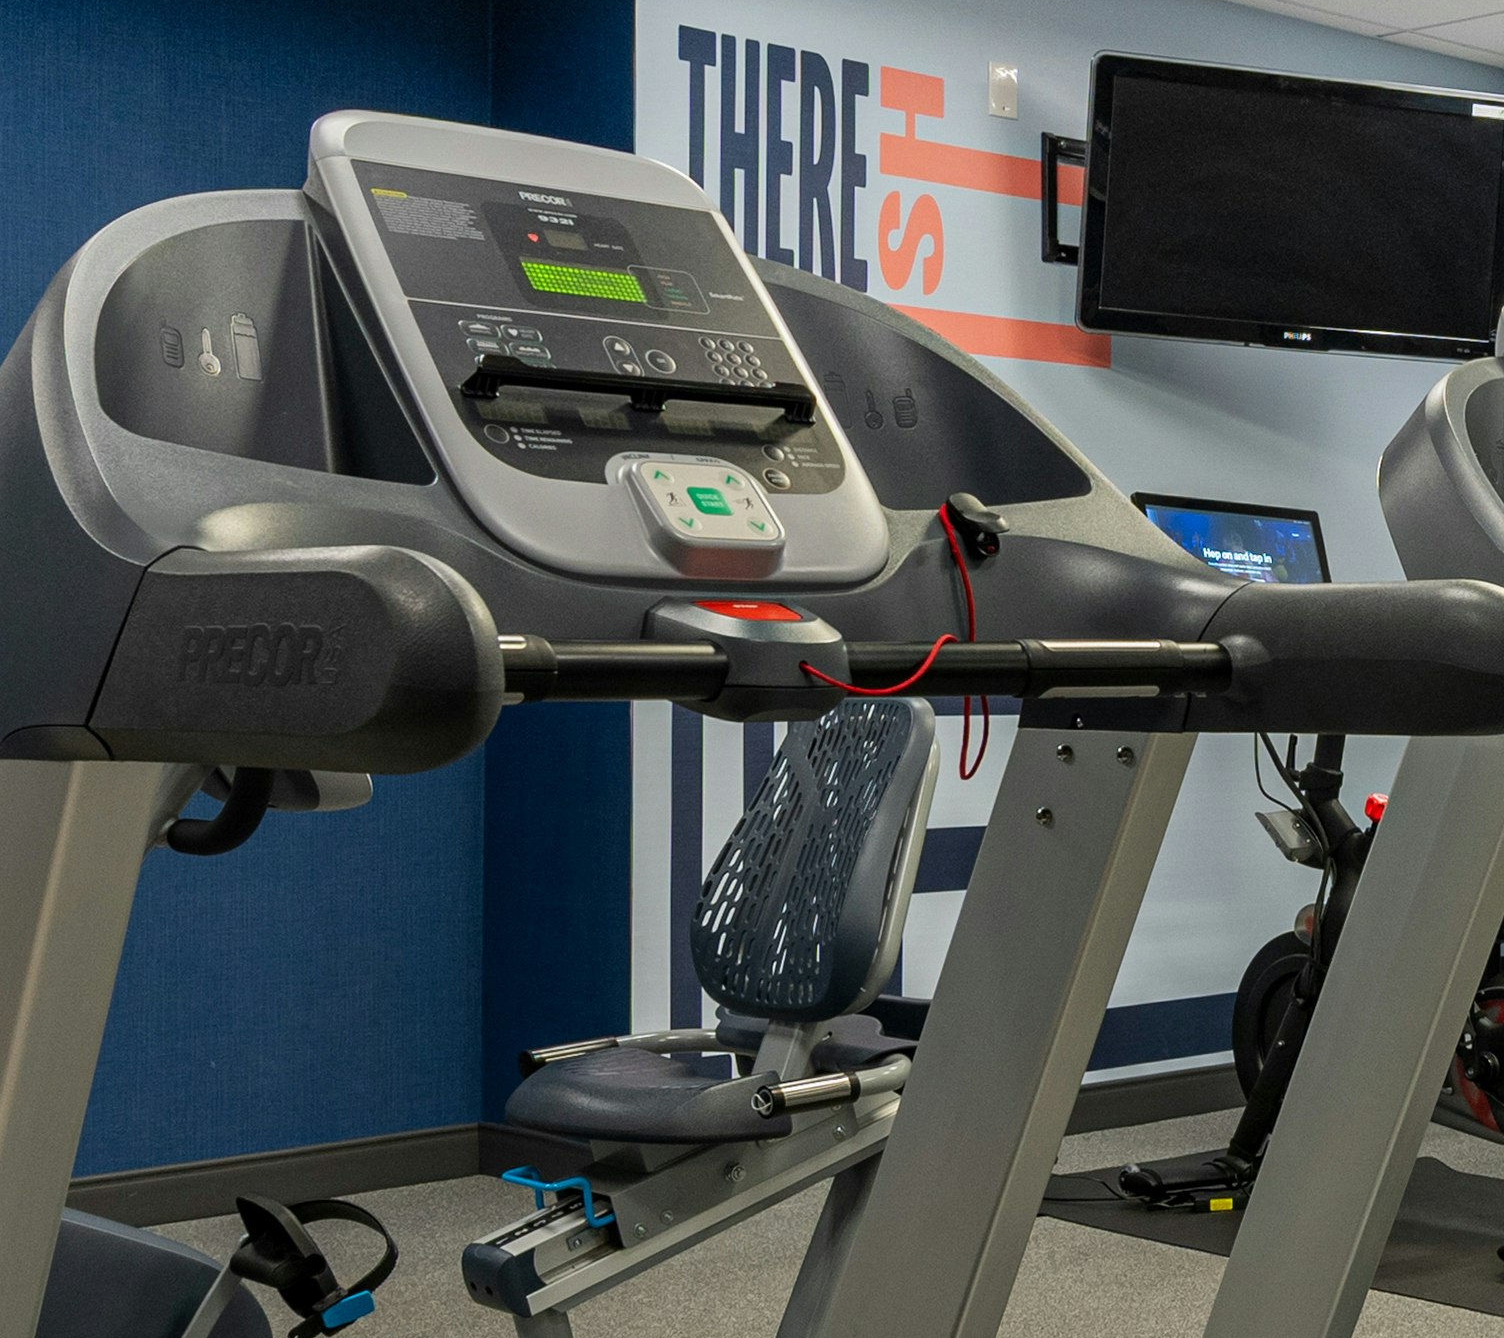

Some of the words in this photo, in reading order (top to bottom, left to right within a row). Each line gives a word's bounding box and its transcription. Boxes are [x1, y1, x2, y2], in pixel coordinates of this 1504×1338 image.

[678, 24, 870, 294] THERE
[518, 191, 567, 206] PRECOR
[1283, 331, 1312, 341] PHILIPS
[696, 493, 720, 501] QUICK
[701, 500, 725, 508] START
[1203, 547, 1221, 561] Hop
[1222, 551, 1233, 560] on
[1234, 551, 1249, 561] and
[1249, 552, 1263, 564] tap
[1263, 552, 1272, 563] in
[177, 622, 323, 687] PRECOR
